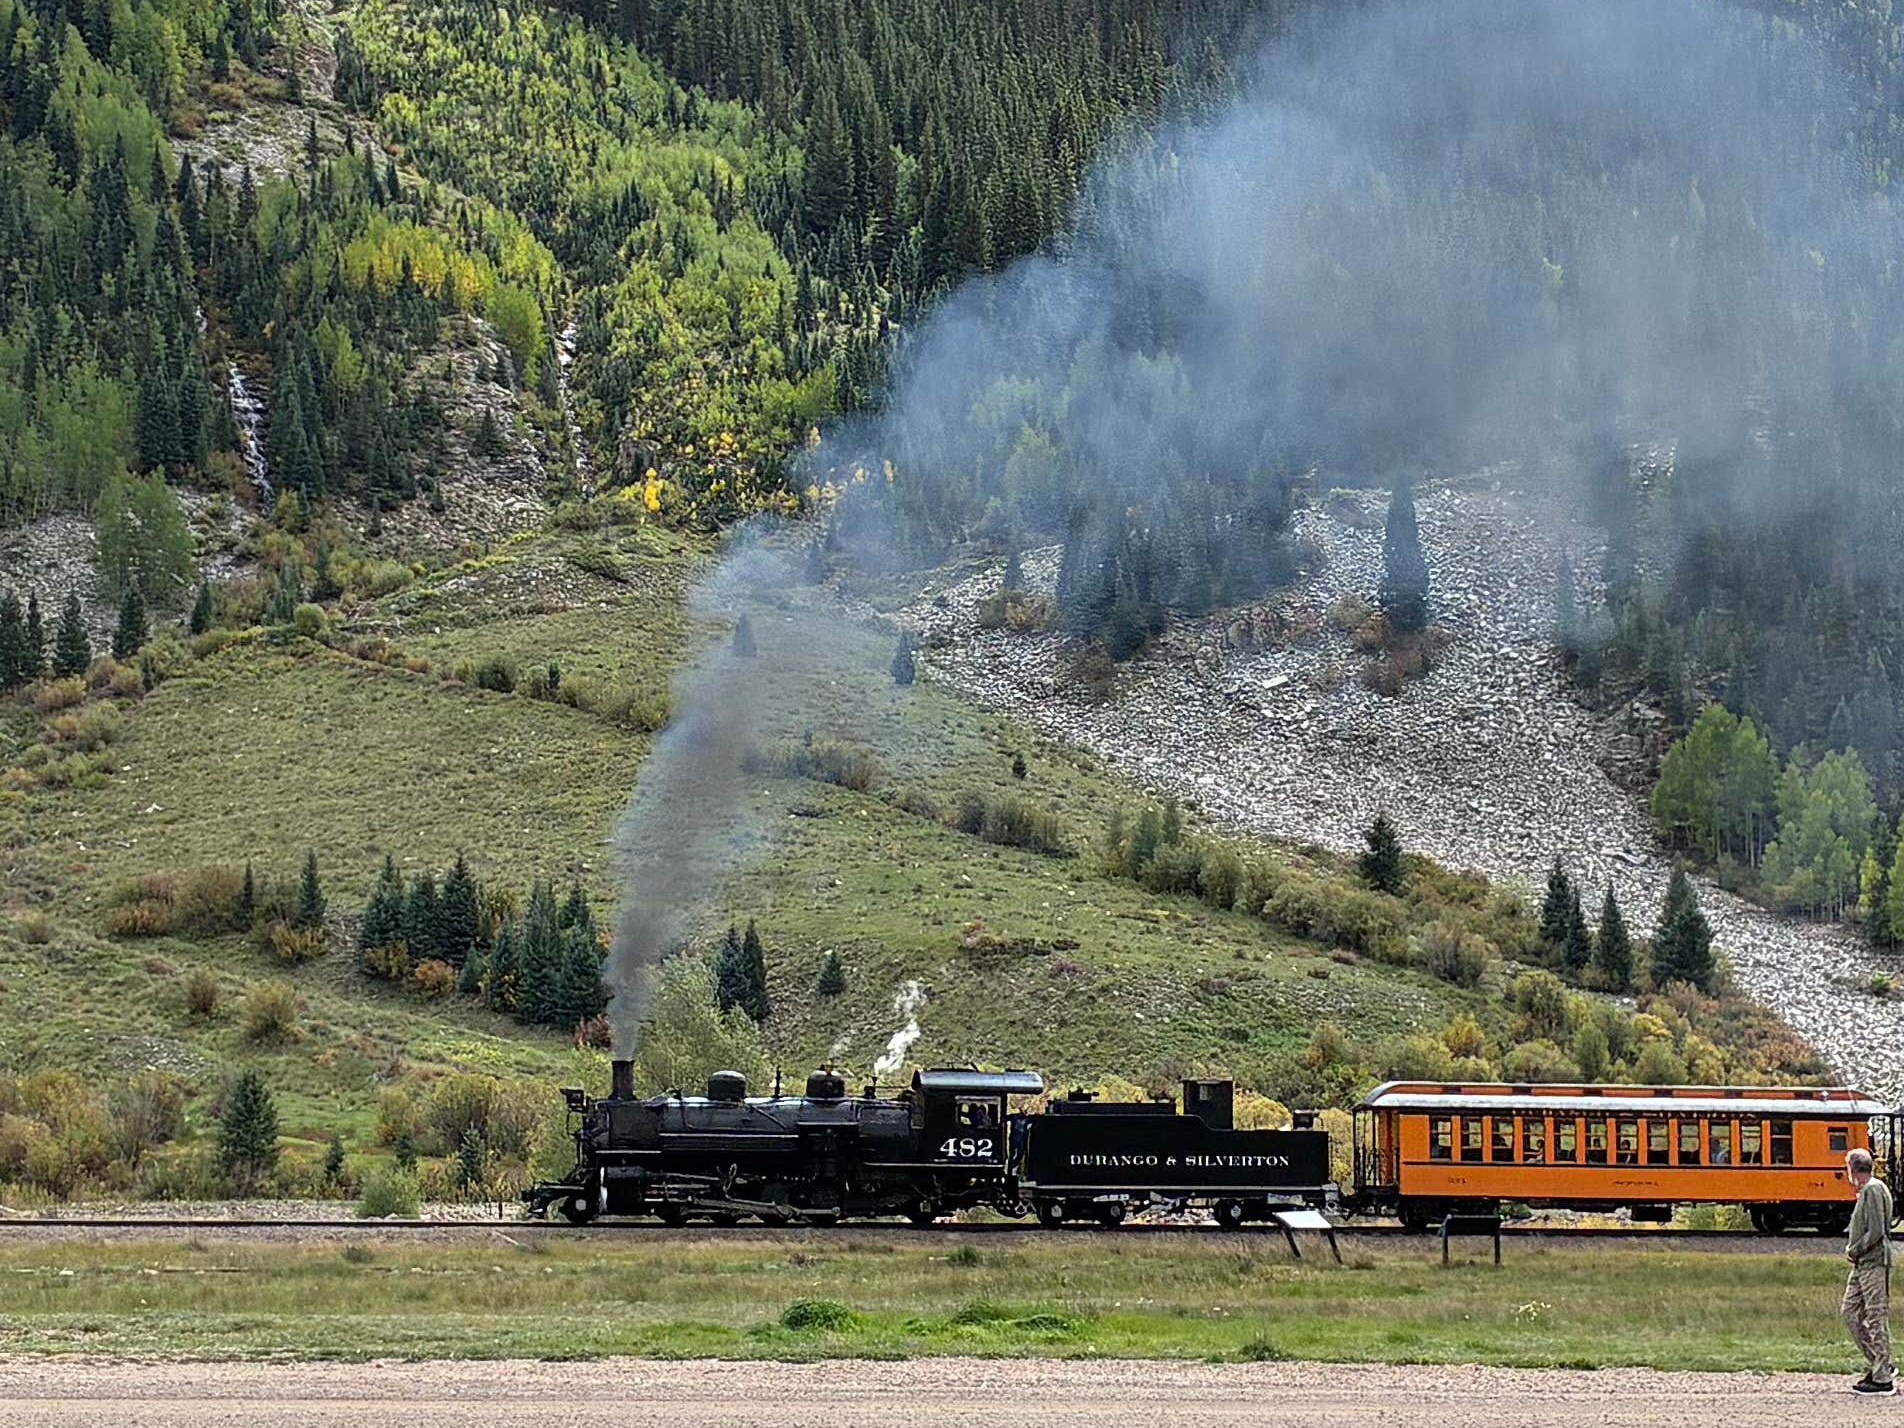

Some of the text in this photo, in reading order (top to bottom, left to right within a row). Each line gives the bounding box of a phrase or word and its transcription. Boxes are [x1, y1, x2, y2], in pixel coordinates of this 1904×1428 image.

[939, 1137, 993, 1158] 482
[1070, 1154, 1290, 1167] DURANGO & SILVERTON
